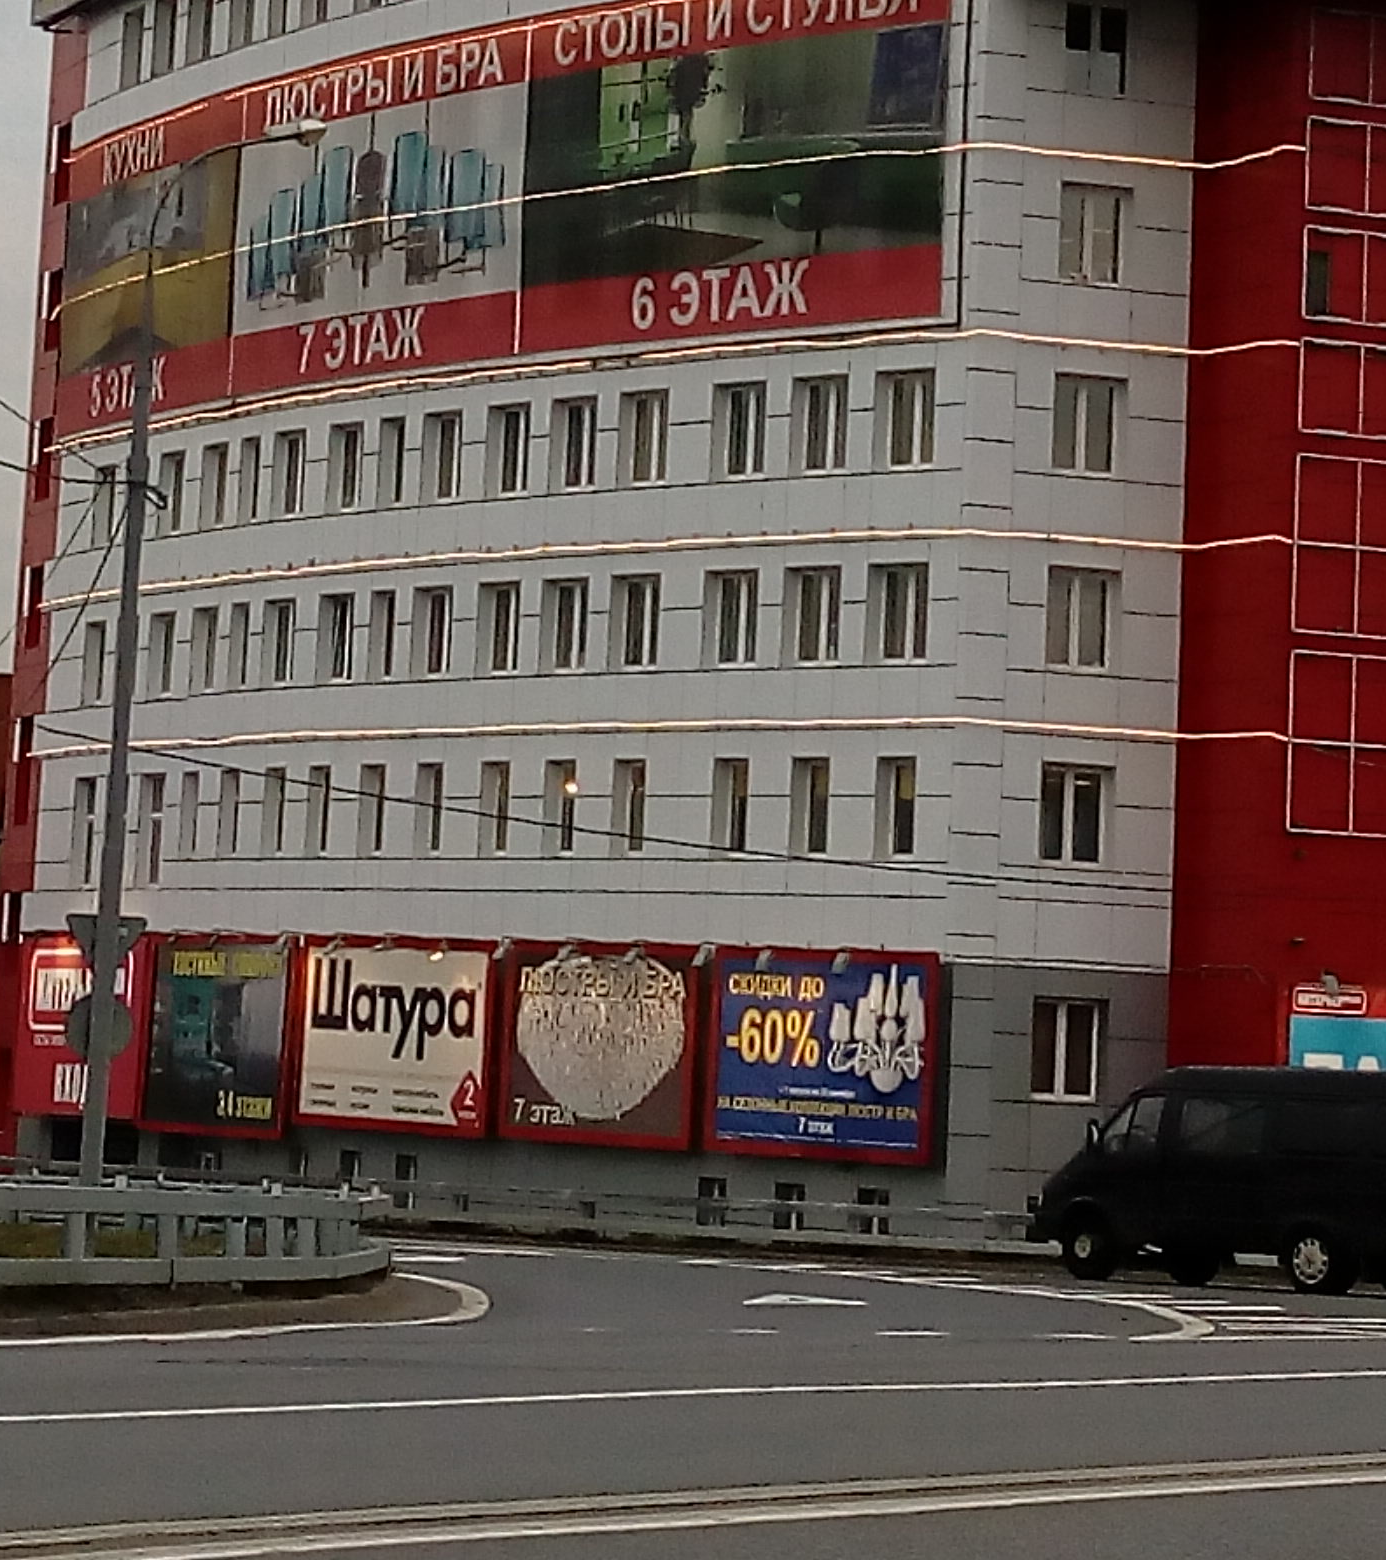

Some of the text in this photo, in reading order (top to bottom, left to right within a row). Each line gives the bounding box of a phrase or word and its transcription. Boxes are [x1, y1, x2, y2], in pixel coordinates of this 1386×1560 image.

[554, 1, 690, 66] СТОЛЫ
[266, 37, 505, 126] ЛЮСТРЫ И БРА
[102, 126, 164, 185] КУХНИ
[631, 258, 810, 331] 6 ЭТАЖ
[298, 306, 426, 374] 7 ЭТАЖ
[89, 366, 101, 417] 5
[312, 958, 476, 1062] Шатура
[798, 976, 825, 1002] ДО
[725, 1007, 821, 1068] -60%
[463, 1081, 475, 1106] 2
[514, 1097, 525, 1122] 7
